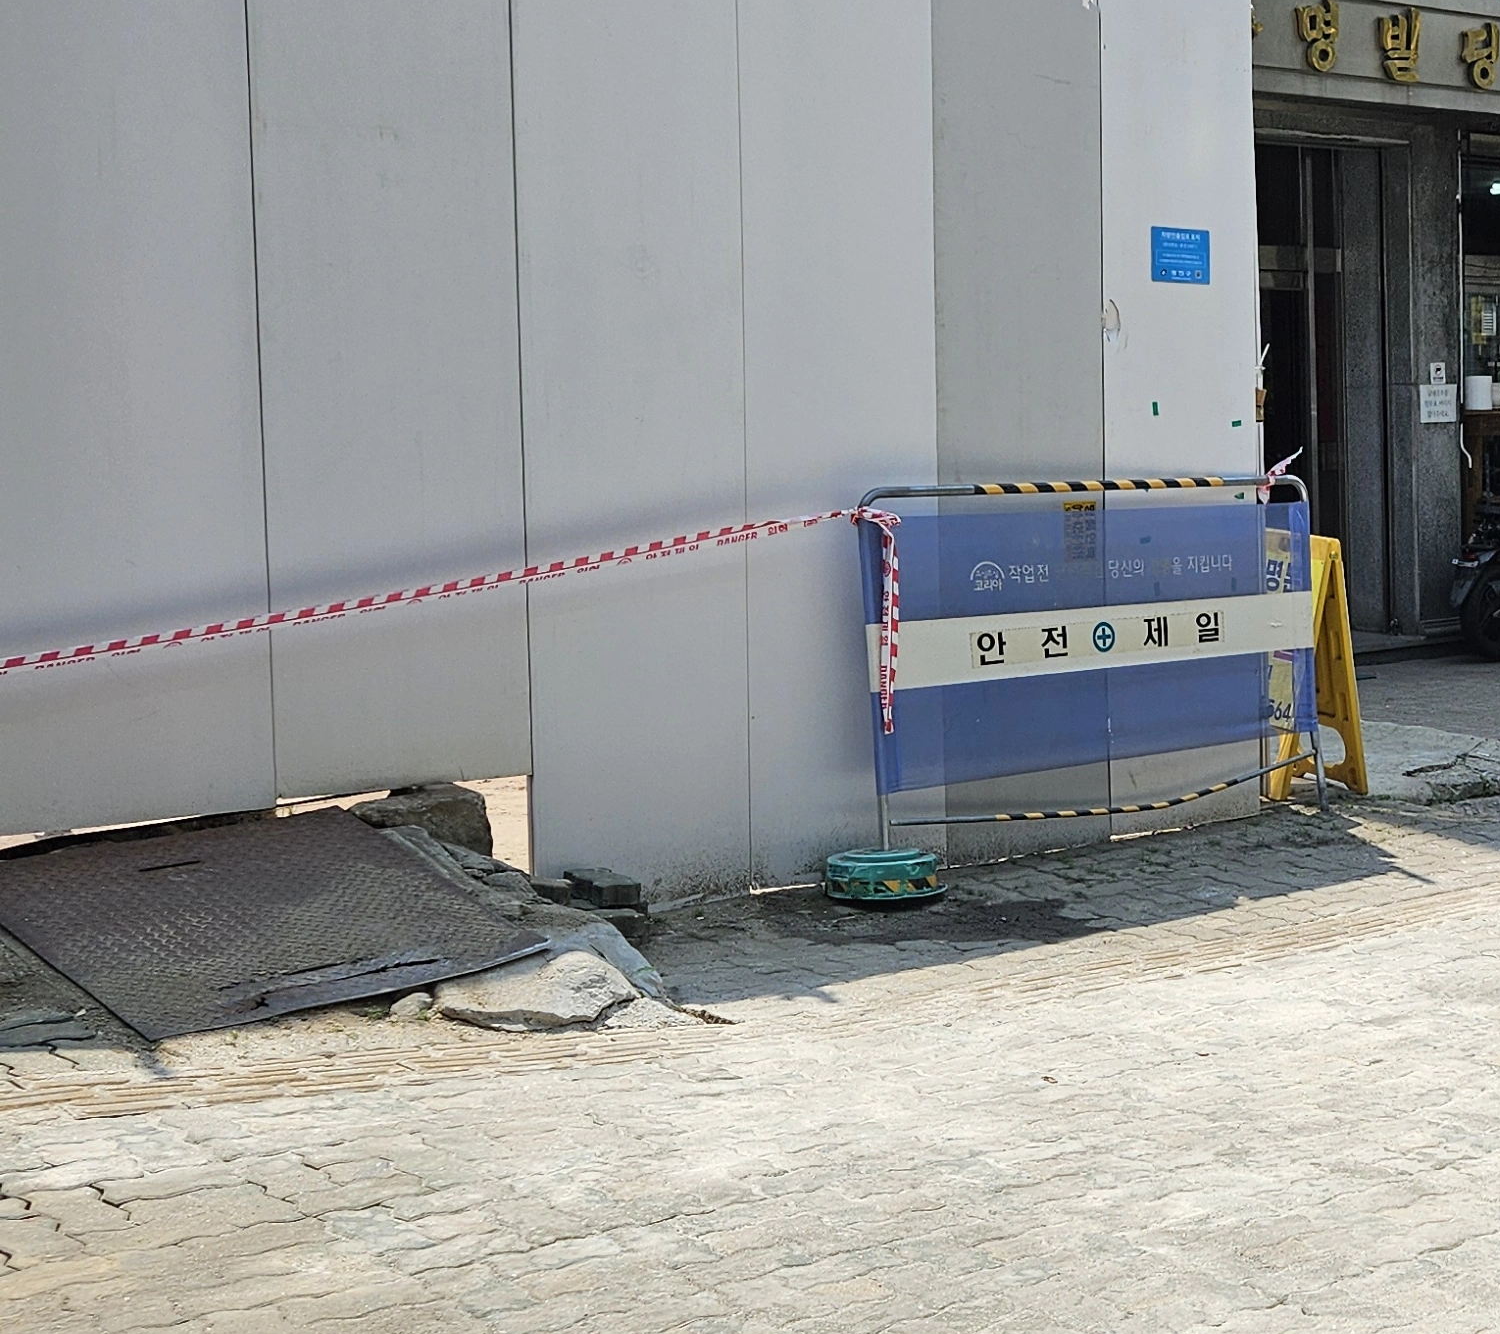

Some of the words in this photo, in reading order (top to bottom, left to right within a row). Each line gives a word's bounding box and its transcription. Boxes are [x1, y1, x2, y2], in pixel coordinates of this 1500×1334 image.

[1108, 558, 1145, 580] 당신의
[1187, 554, 1233, 575] 지킵니다
[974, 578, 1003, 592] 코리아
